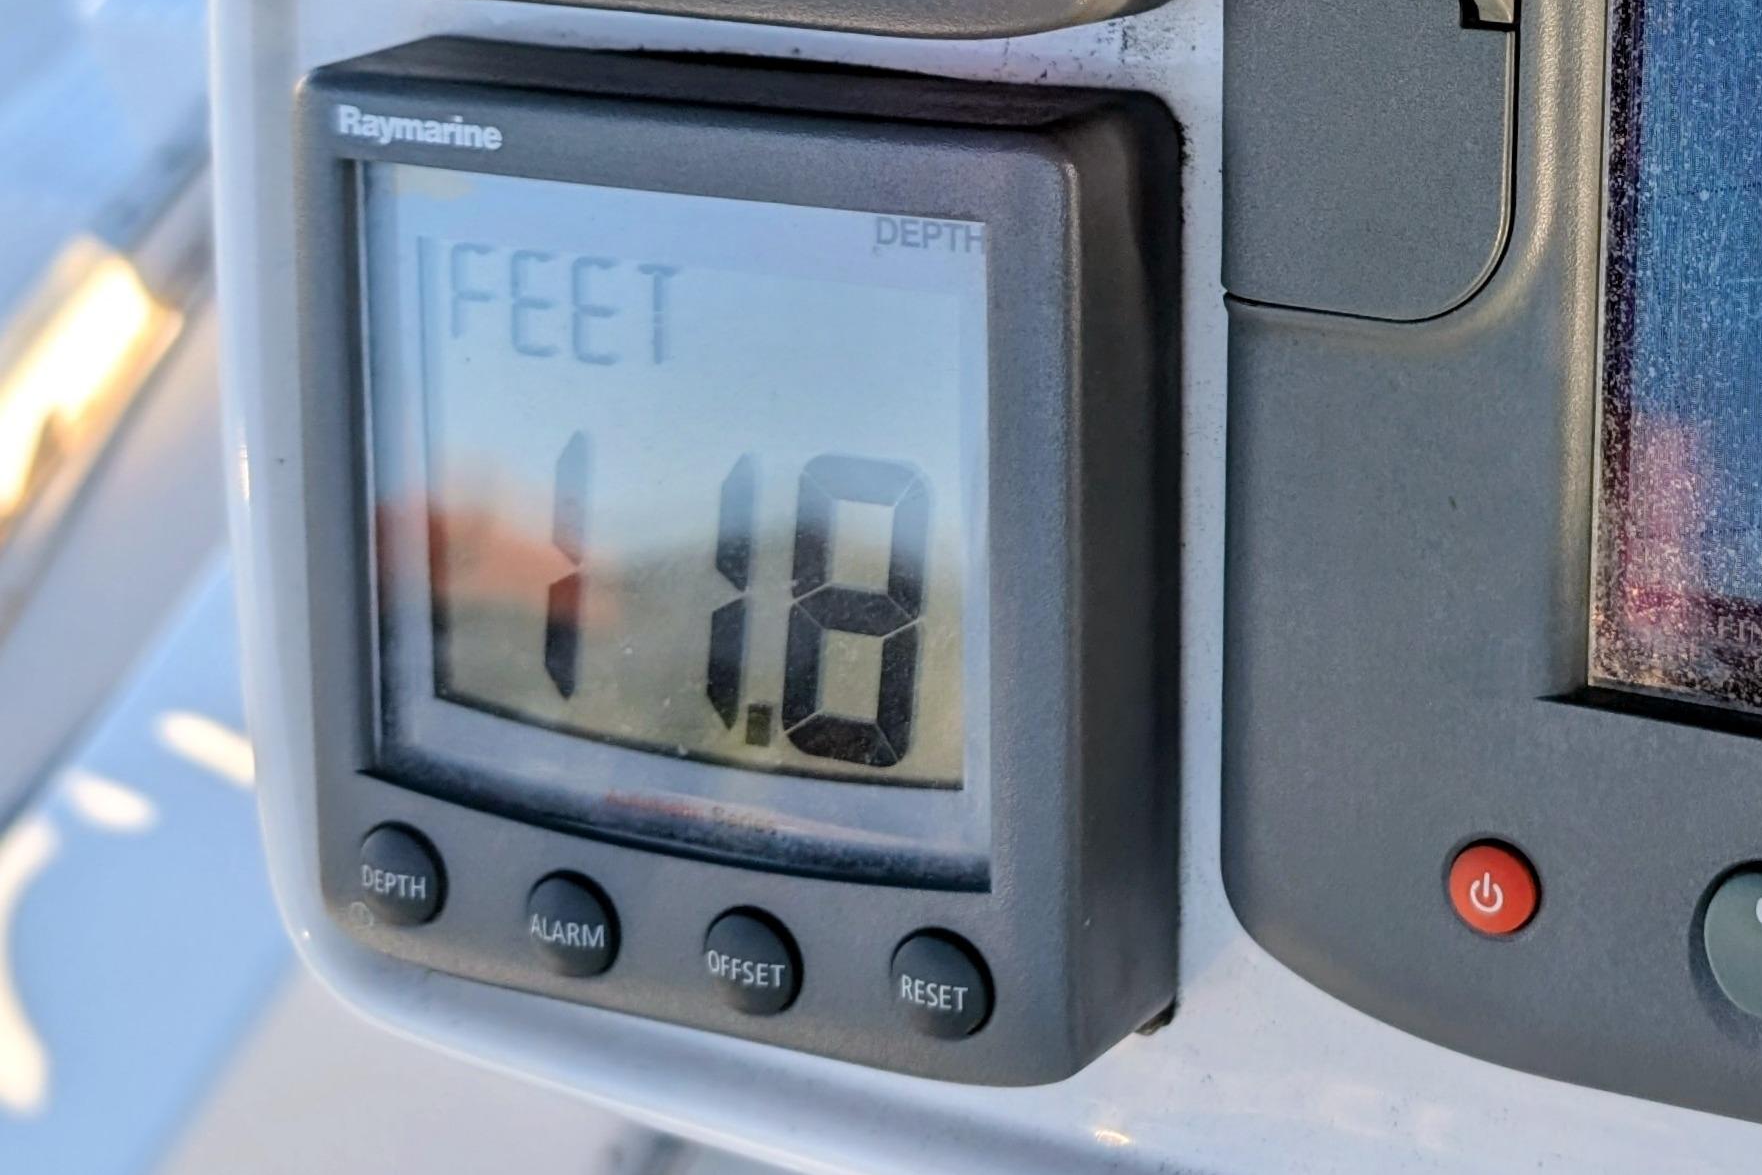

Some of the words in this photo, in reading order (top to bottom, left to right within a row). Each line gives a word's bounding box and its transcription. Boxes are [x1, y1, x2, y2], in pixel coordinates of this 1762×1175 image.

[338, 104, 503, 150] Raymarine
[875, 215, 985, 254] DEPTH
[450, 242, 682, 366] FEET
[362, 862, 426, 900] DEPTH
[529, 912, 605, 949] ALARM
[707, 948, 786, 988] OFFSET
[900, 973, 968, 1013] RESET
